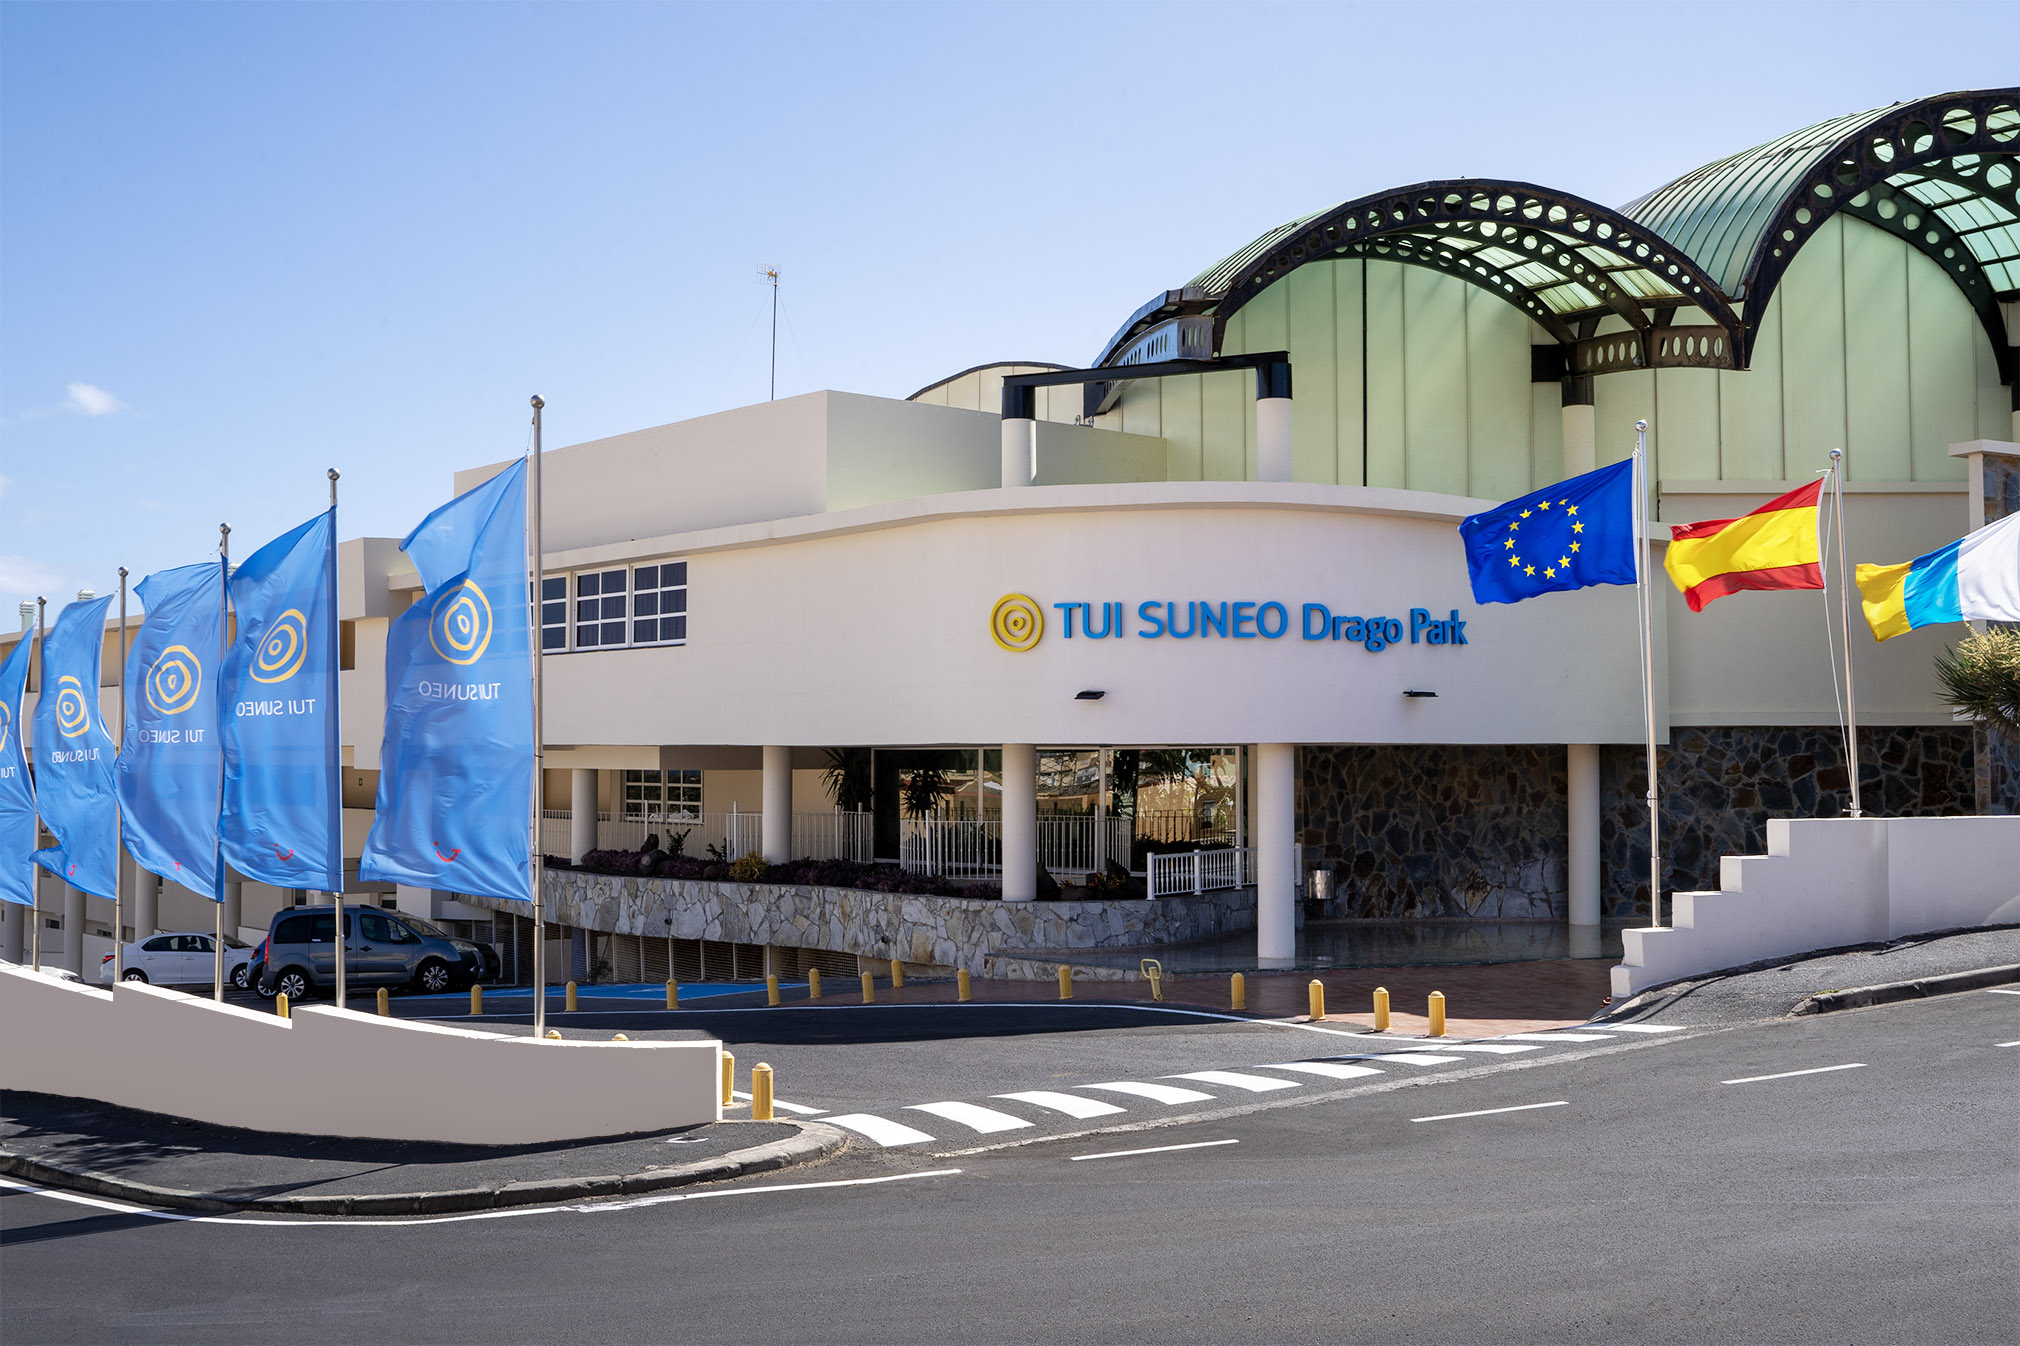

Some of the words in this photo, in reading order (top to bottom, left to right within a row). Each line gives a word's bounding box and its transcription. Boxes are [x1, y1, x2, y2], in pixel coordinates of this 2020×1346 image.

[1053, 602, 1122, 640] TUI
[1138, 600, 1288, 640] SUNEO
[1302, 603, 1404, 652] Drago
[1410, 608, 1468, 645] Park
